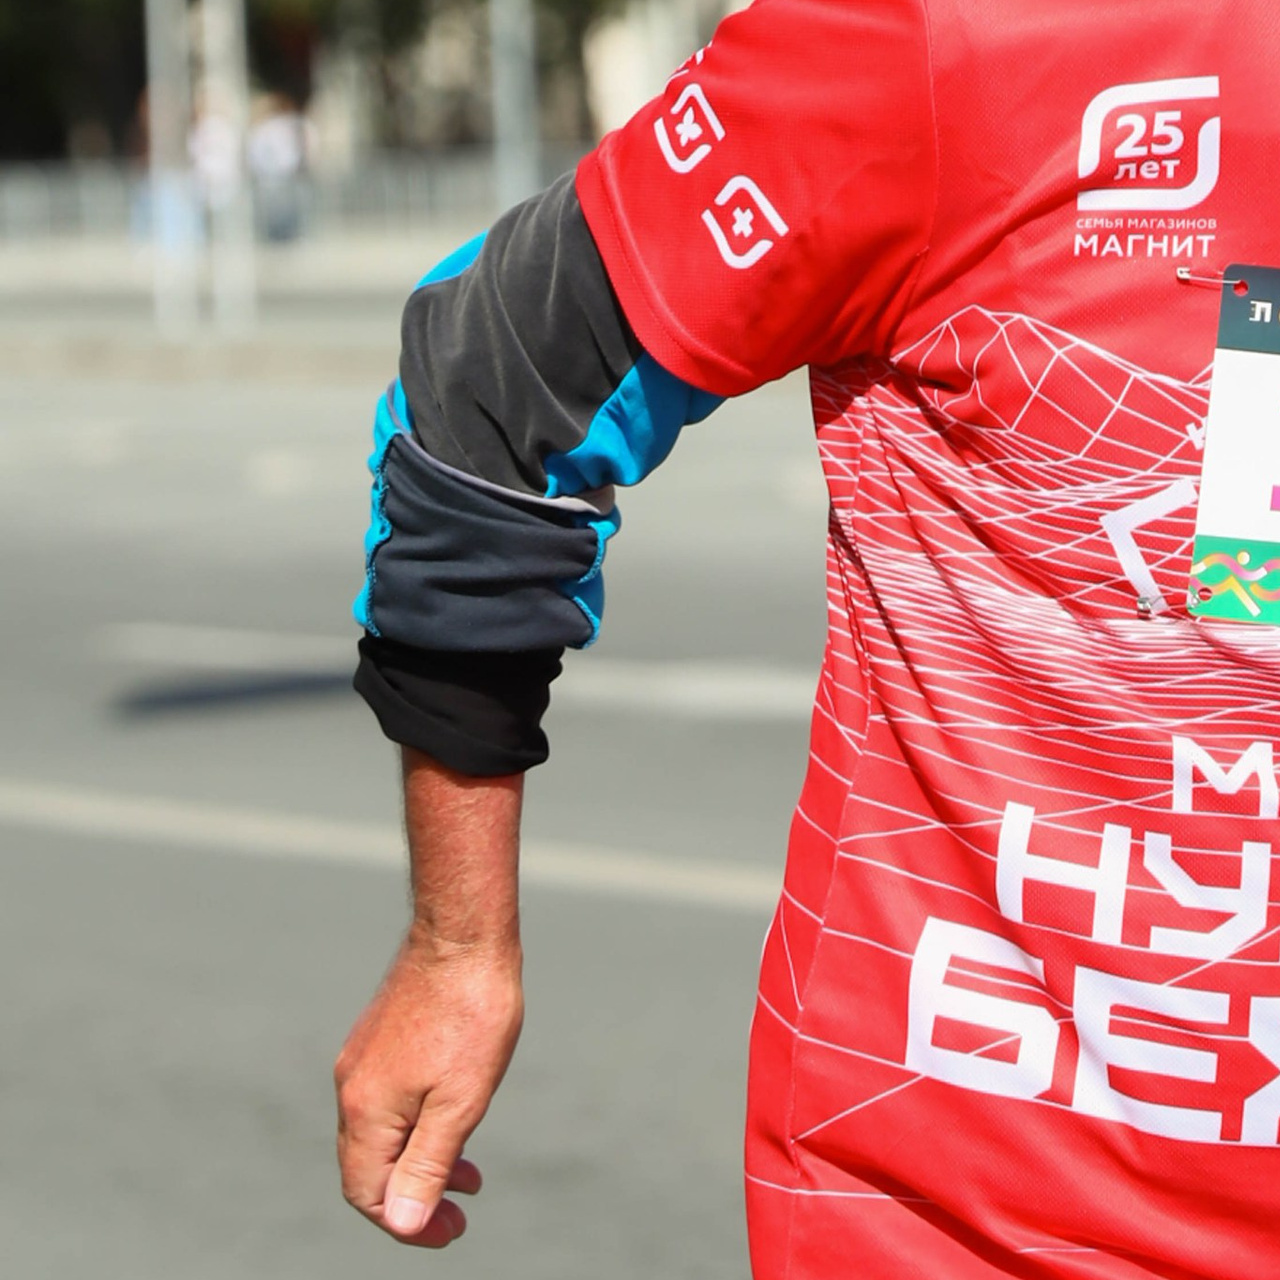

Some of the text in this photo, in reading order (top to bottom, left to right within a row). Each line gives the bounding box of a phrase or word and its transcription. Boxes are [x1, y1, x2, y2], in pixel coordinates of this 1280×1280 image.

[1114, 110, 1184, 159] 25
[1114, 159, 1180, 180] лет
[1076, 218, 1217, 229] СЕМЬЯ МАГАЗИНОВ
[1074, 233, 1215, 257] МАГНИТ
